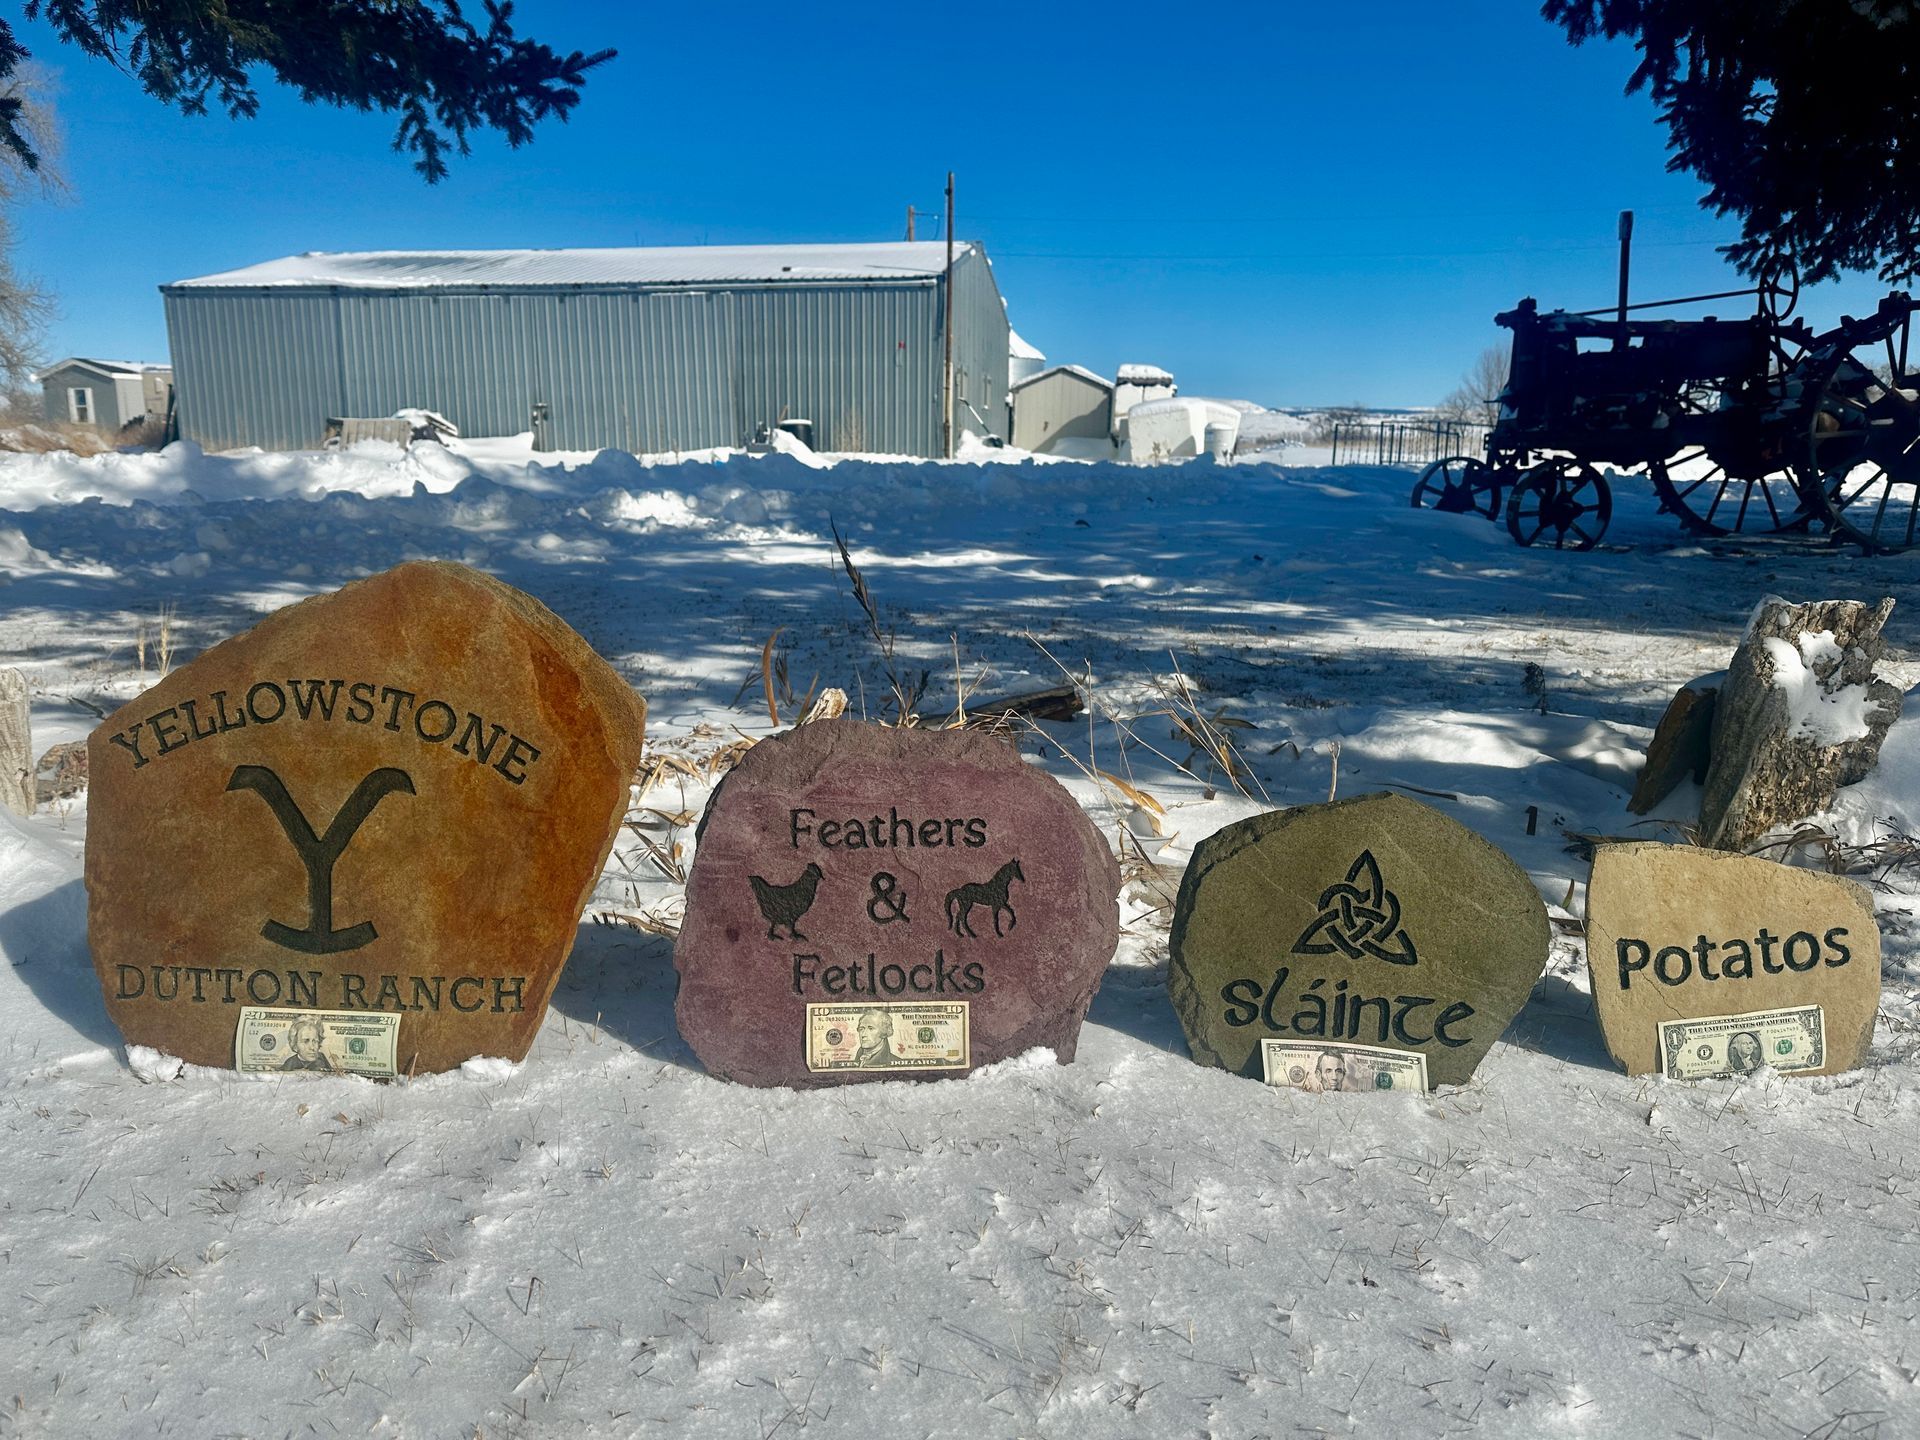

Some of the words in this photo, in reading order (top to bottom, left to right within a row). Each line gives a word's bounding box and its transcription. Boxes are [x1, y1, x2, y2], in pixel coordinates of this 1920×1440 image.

[109, 680, 541, 786] YELLOWSTONE
[790, 806, 987, 850] Feathers
[867, 872, 910, 924] &
[1616, 927, 1851, 990] Potatos
[793, 950, 985, 995] Fetlocks
[116, 963, 323, 1008] DUTTON
[340, 973, 526, 1013] RANCH
[813, 1008, 830, 1016] 10
[945, 1006, 963, 1014] 10
[1220, 967, 1475, 1047] sláinte
[245, 1011, 266, 1020] 20
[379, 1016, 396, 1025] 20
[1731, 1022, 1755, 1030] STATES
[1766, 1017, 1796, 1026] AMERICA
[1810, 1016, 1815, 1028] 1
[1672, 1033, 1678, 1045] 1
[1269, 1044, 1281, 1052] 5
[1407, 1057, 1420, 1065] 5
